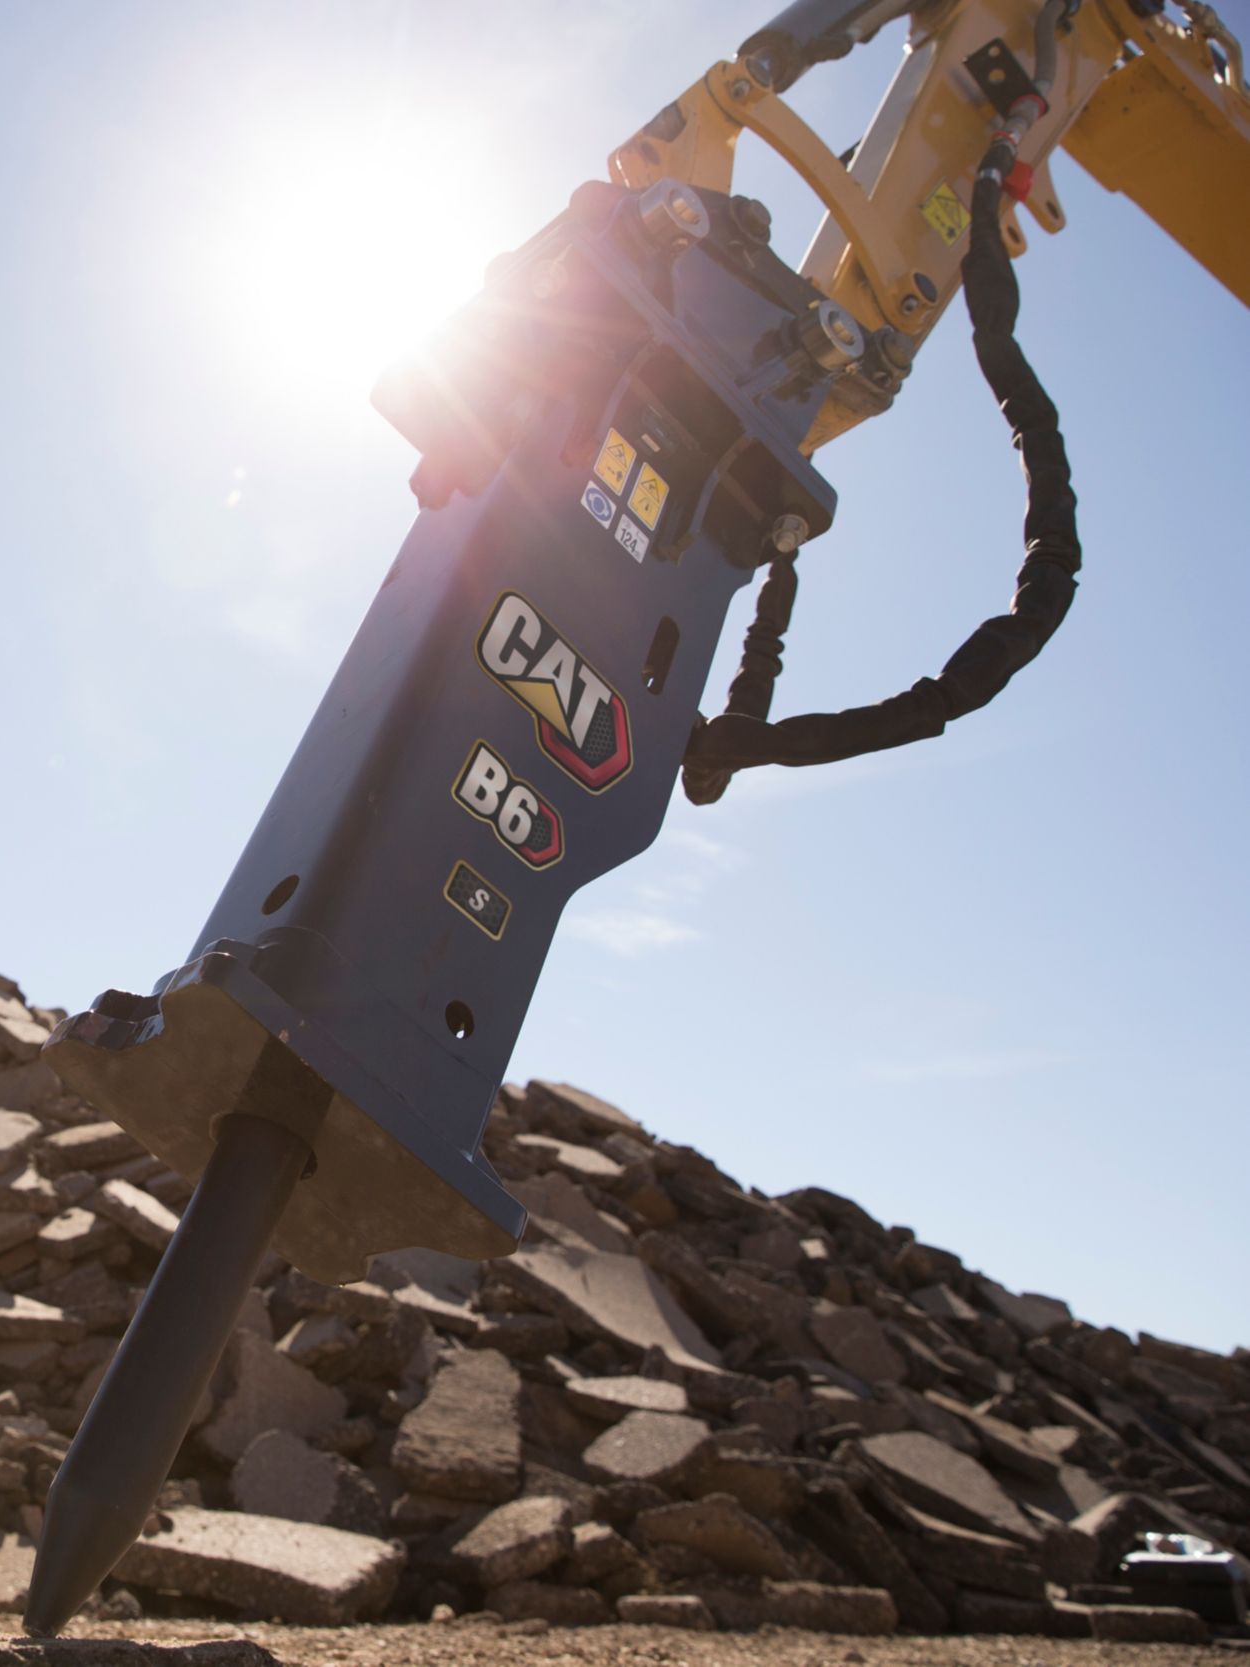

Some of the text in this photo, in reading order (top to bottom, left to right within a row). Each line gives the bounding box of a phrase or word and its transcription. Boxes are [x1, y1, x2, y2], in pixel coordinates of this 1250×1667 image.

[620, 528, 638, 552] 124
[482, 595, 612, 749] CAT
[459, 747, 539, 845] B6
[468, 888, 490, 911] S
